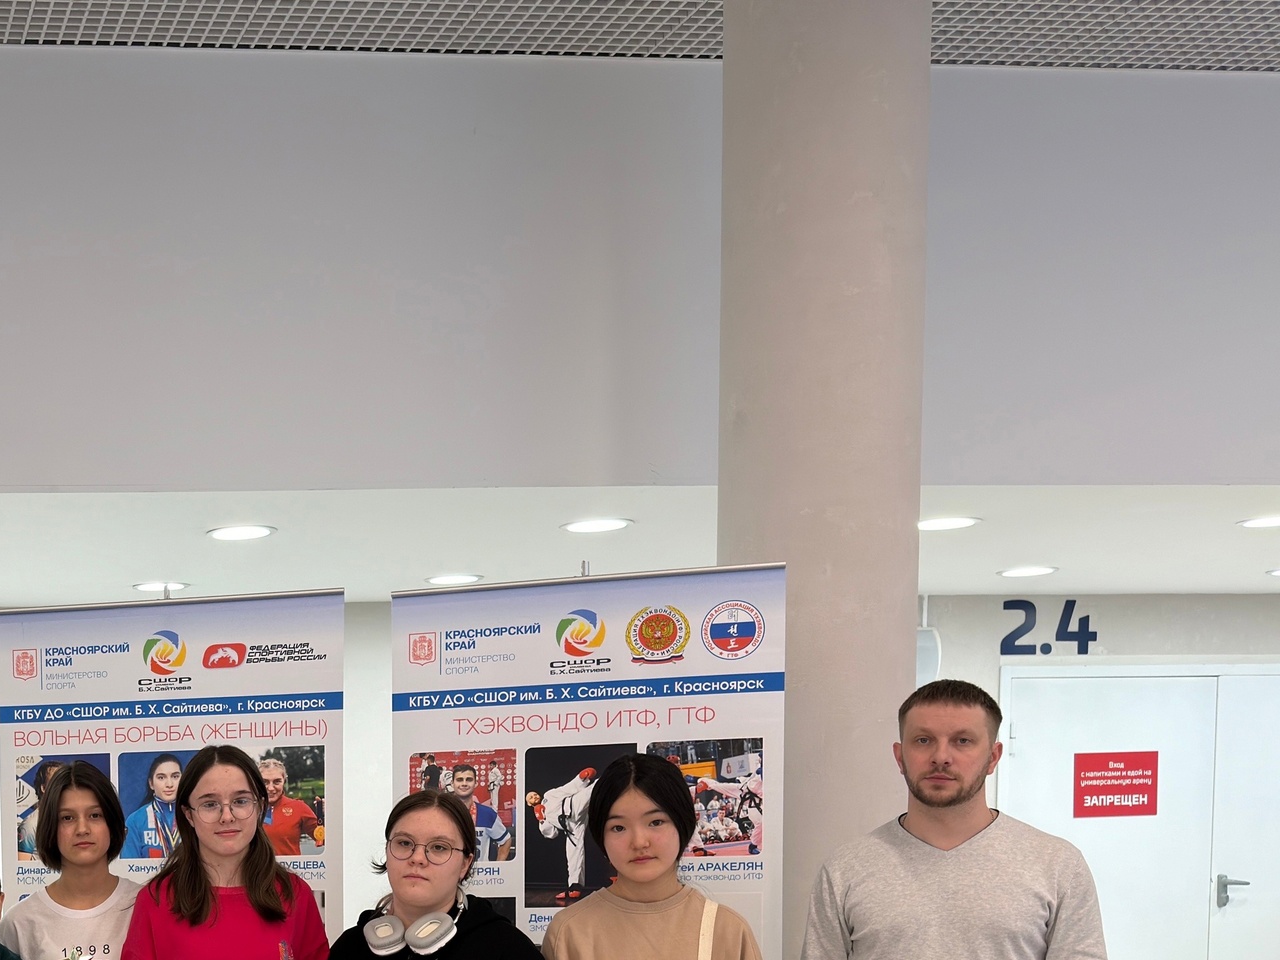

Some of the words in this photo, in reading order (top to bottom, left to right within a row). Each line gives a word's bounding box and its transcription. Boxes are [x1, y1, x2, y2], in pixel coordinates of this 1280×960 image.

[713, 602, 755, 614] АССОЦИАЦИЯ
[445, 623, 541, 639] КРАСНОЯРСКИЙ
[1000, 599, 1098, 655] 2.4
[45, 642, 130, 657] КРАСНОЯРСКИЙ
[249, 643, 310, 651] ФЕДЕРАЦИЯ
[445, 640, 476, 651] КРАЙ
[248, 648, 314, 657] СПОРТИВНОЙ
[45, 657, 73, 667] КРАЙ
[246, 656, 286, 664] БОРЬБЫ
[445, 653, 516, 665] МИНИСТЕРСТВО
[46, 671, 108, 680] МИНИСТЕРСТВО
[445, 667, 480, 676] СПОРТА
[46, 682, 76, 690] СПОРТА
[408, 694, 439, 708] КГБУ
[442, 693, 465, 707] ДО
[467, 690, 518, 704] «СШОР
[520, 691, 543, 701] им.
[545, 689, 558, 700] Б.
[561, 687, 574, 699] Х.
[577, 685, 657, 698] Сайтиева»,
[663, 684, 671, 694] г.
[674, 678, 765, 694] Красноярск
[14, 708, 42, 720] КГБУ
[44, 708, 64, 721] ДО
[66, 706, 110, 719] «СШОР
[112, 707, 132, 717] им.
[135, 704, 146, 715] Б.
[148, 703, 160, 714] Х.
[162, 702, 232, 714] Сайтиева»,
[237, 702, 245, 711] г.
[247, 698, 326, 712] Красноярск
[453, 711, 598, 735] ТХЭКВОНДО
[606, 708, 661, 729] ИТФ,
[668, 706, 716, 725] ГТФ
[14, 727, 107, 747] ВОЛЬНАЯ
[114, 724, 195, 744] БОРЬБА
[200, 719, 328, 743] (ЖЕНЩИНЫ)
[1108, 761, 1125, 769] Вход
[1081, 778, 1132, 787] универсальную
[1083, 794, 1148, 807] ЗАПРЕЩЕН
[16, 866, 52, 876] Динара
[128, 863, 158, 874] Ханум
[697, 861, 763, 872] АРАКЕЛЯН
[17, 877, 46, 885] МСМК
[743, 872, 763, 880] ИТФ
[485, 878, 505, 886] ИТФ
